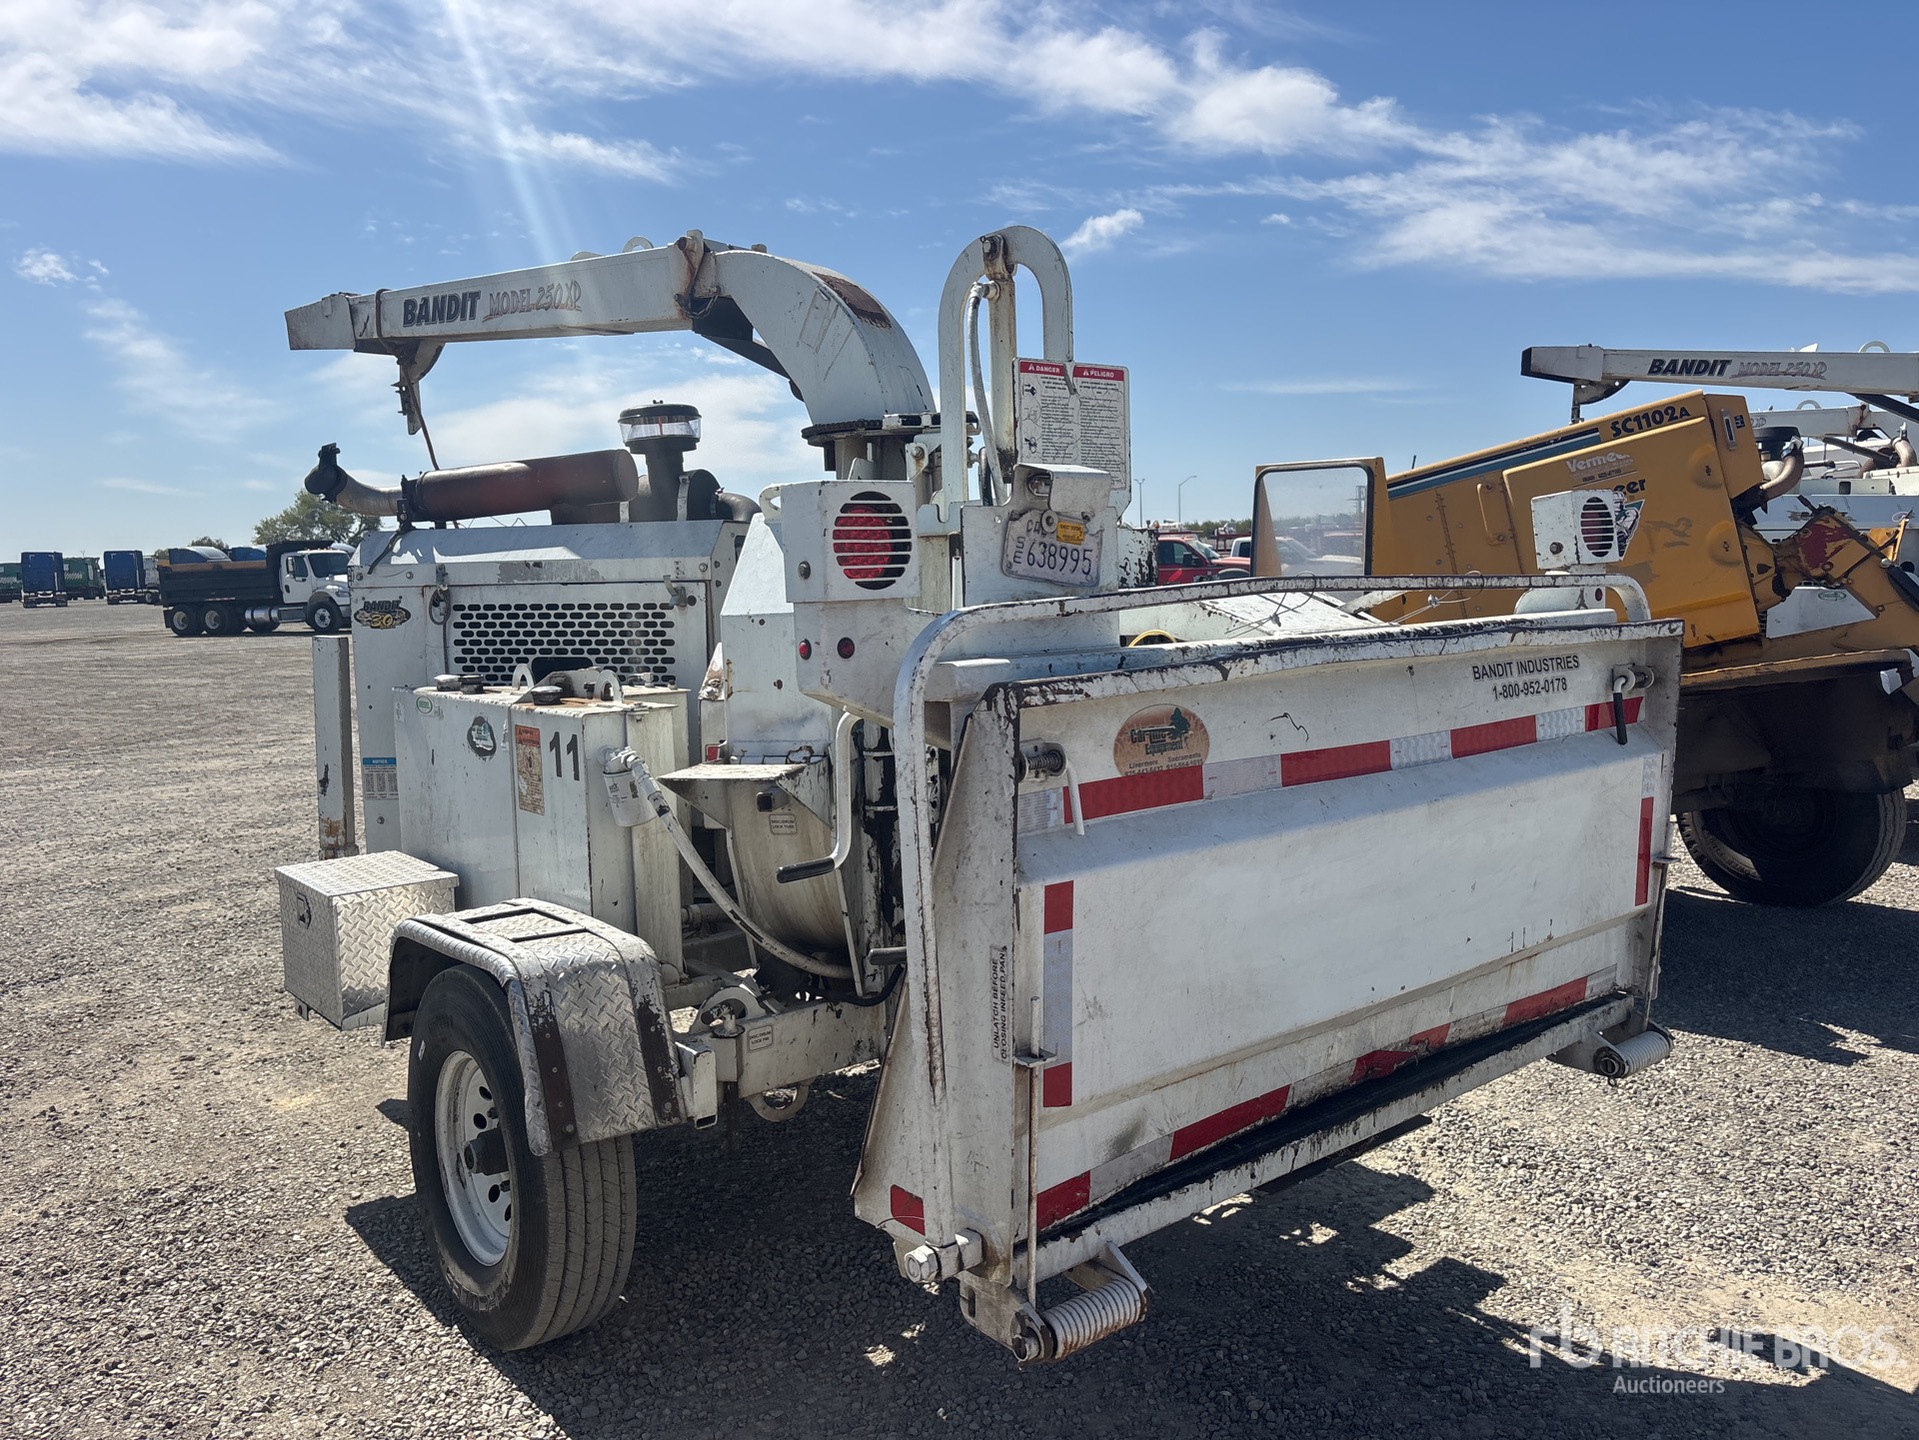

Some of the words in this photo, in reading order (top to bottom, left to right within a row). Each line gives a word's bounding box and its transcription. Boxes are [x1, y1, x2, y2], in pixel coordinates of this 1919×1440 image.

[403, 290, 481, 328] BANDIT
[488, 288, 532, 318] MODEL
[1036, 365, 1061, 374] DANGER
[1090, 370, 1115, 378] PELIGRO
[1647, 358, 1733, 377] BANDIT
[1737, 362, 1782, 377] MODEL
[1610, 405, 1691, 438] SC1102A
[1027, 541, 1094, 576] 638995
[364, 600, 402, 613] BANDIT
[1472, 661, 1514, 681] BANDIT
[1516, 654, 1580, 675] INDUSTRIES
[1492, 677, 1568, 700] 1-800-952-0178
[549, 730, 580, 782] 11
[1129, 759, 1158, 769] Livermore
[1167, 753, 1201, 763] Sacramento
[1000, 1014, 1008, 1060] CLOSING
